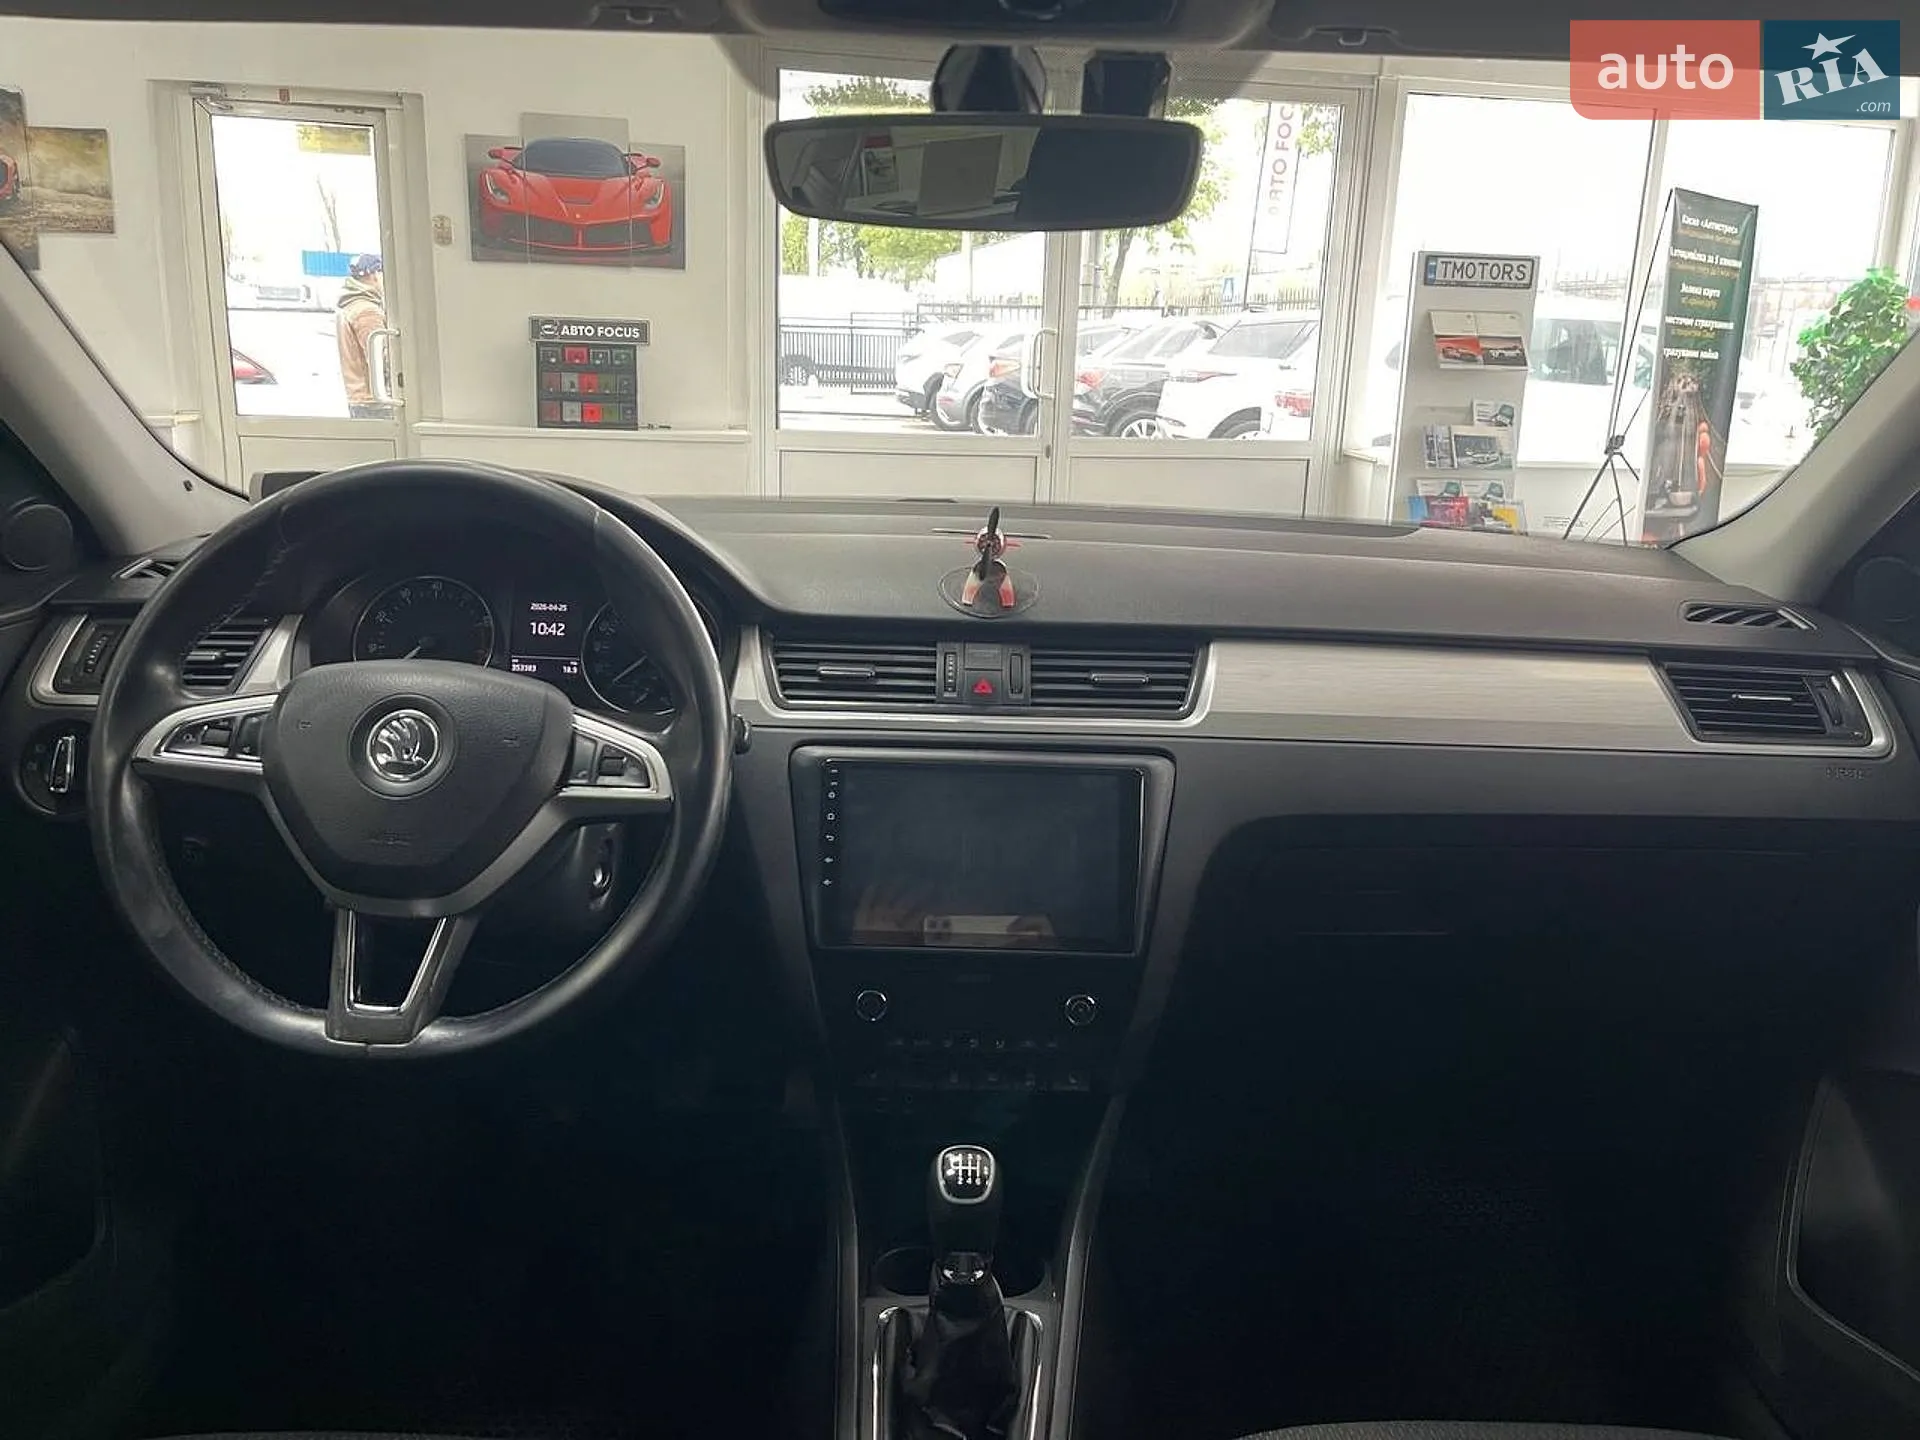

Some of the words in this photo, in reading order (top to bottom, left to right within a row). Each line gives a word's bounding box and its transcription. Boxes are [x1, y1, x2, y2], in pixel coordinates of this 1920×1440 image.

[1275, 102, 1295, 151] FOC
[1440, 260, 1527, 281] TMOTORS
[597, 326, 640, 338] FOCUS
[530, 622, 566, 636] 10:42
